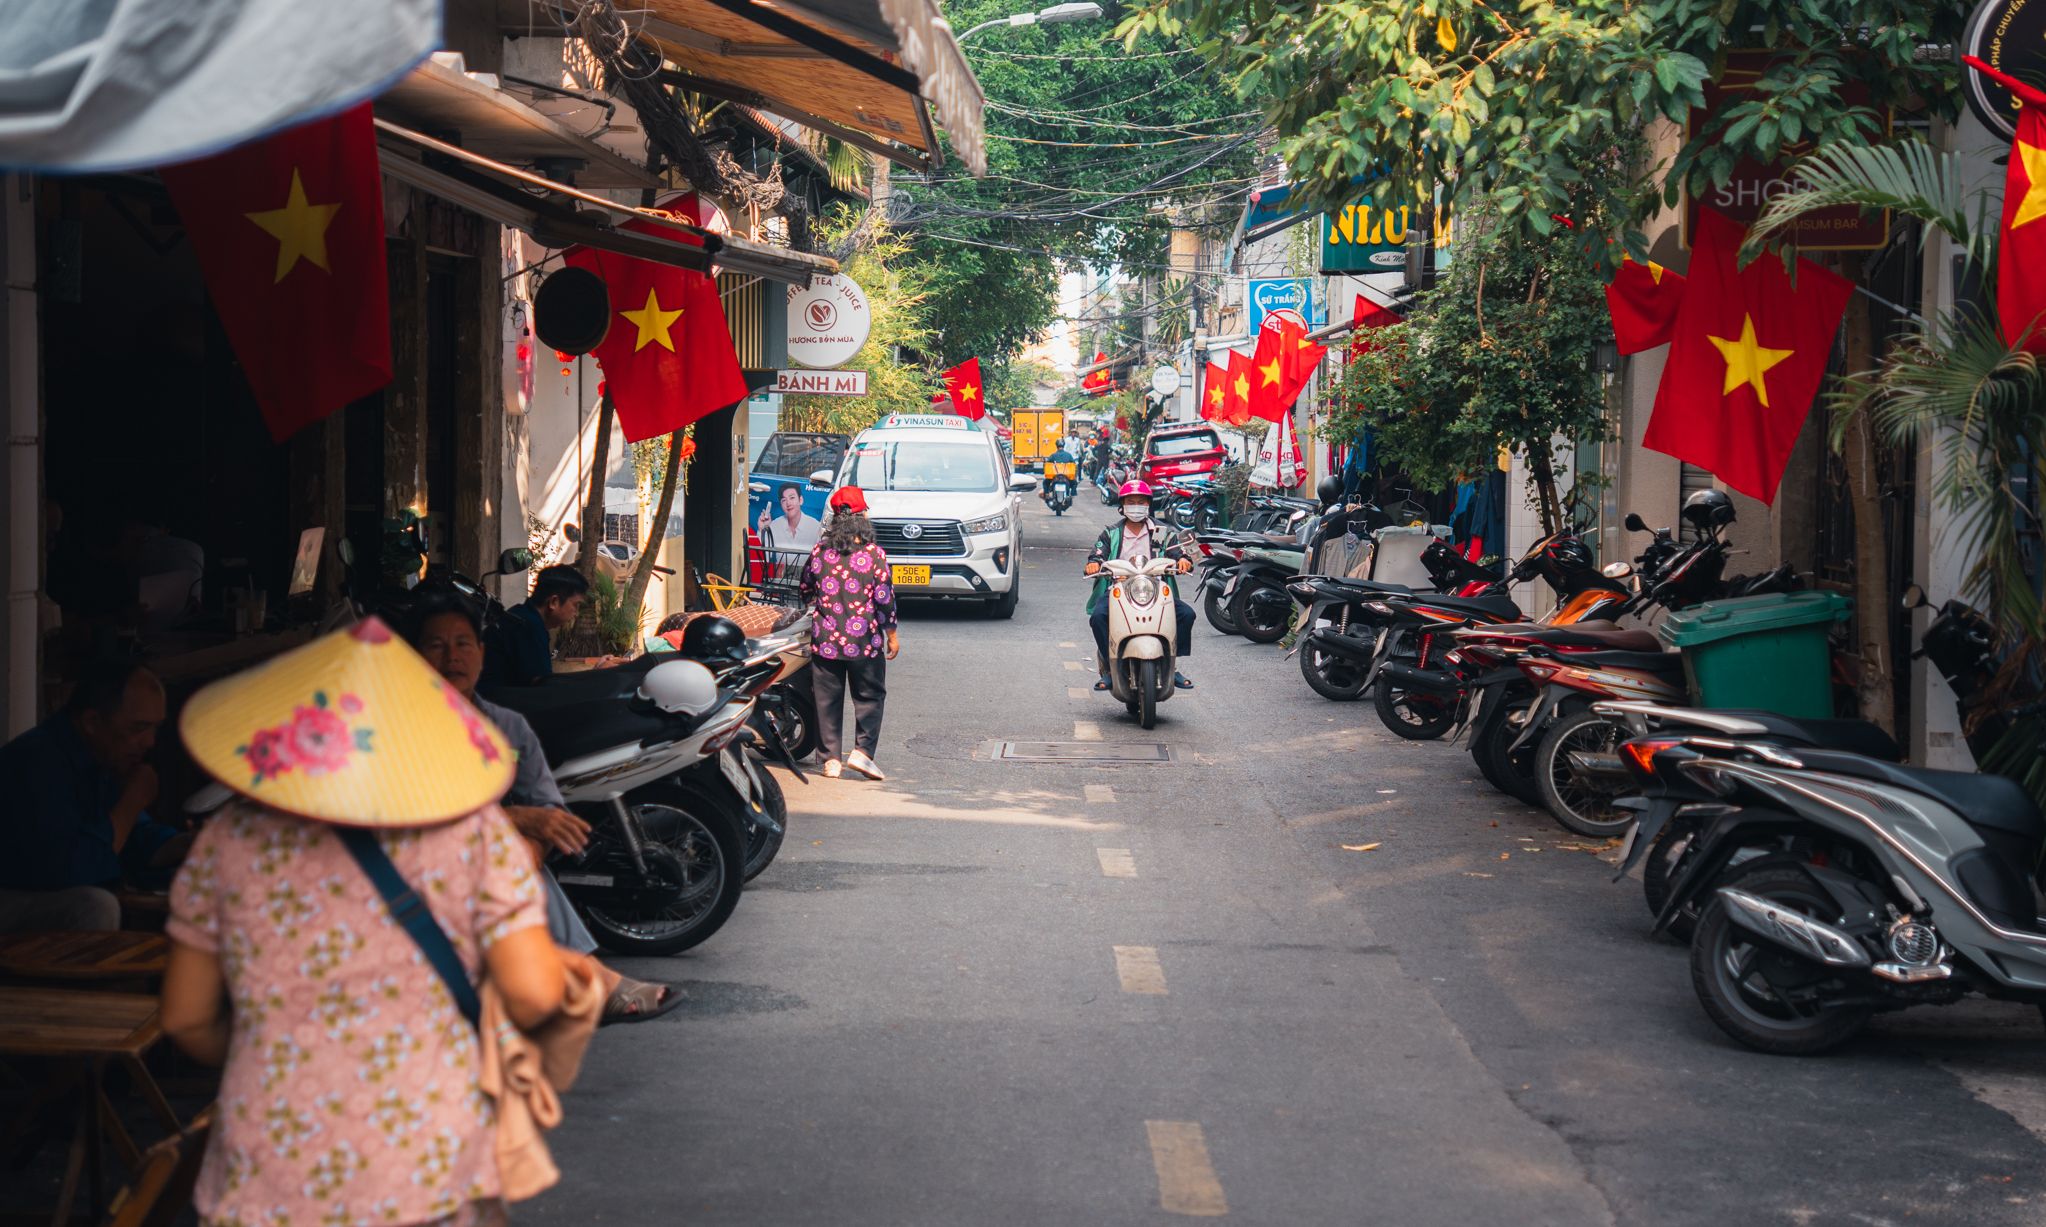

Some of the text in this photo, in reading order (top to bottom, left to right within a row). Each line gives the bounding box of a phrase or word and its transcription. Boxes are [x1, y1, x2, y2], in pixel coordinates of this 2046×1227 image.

[1834, 218, 1858, 230] BAR
[815, 276, 833, 287] TEA
[840, 286, 862, 311] JUICE
[778, 371, 857, 392] BÁNH MÌ
[904, 417, 962, 427] VINASUN TAXI
[903, 567, 919, 575] 50E
